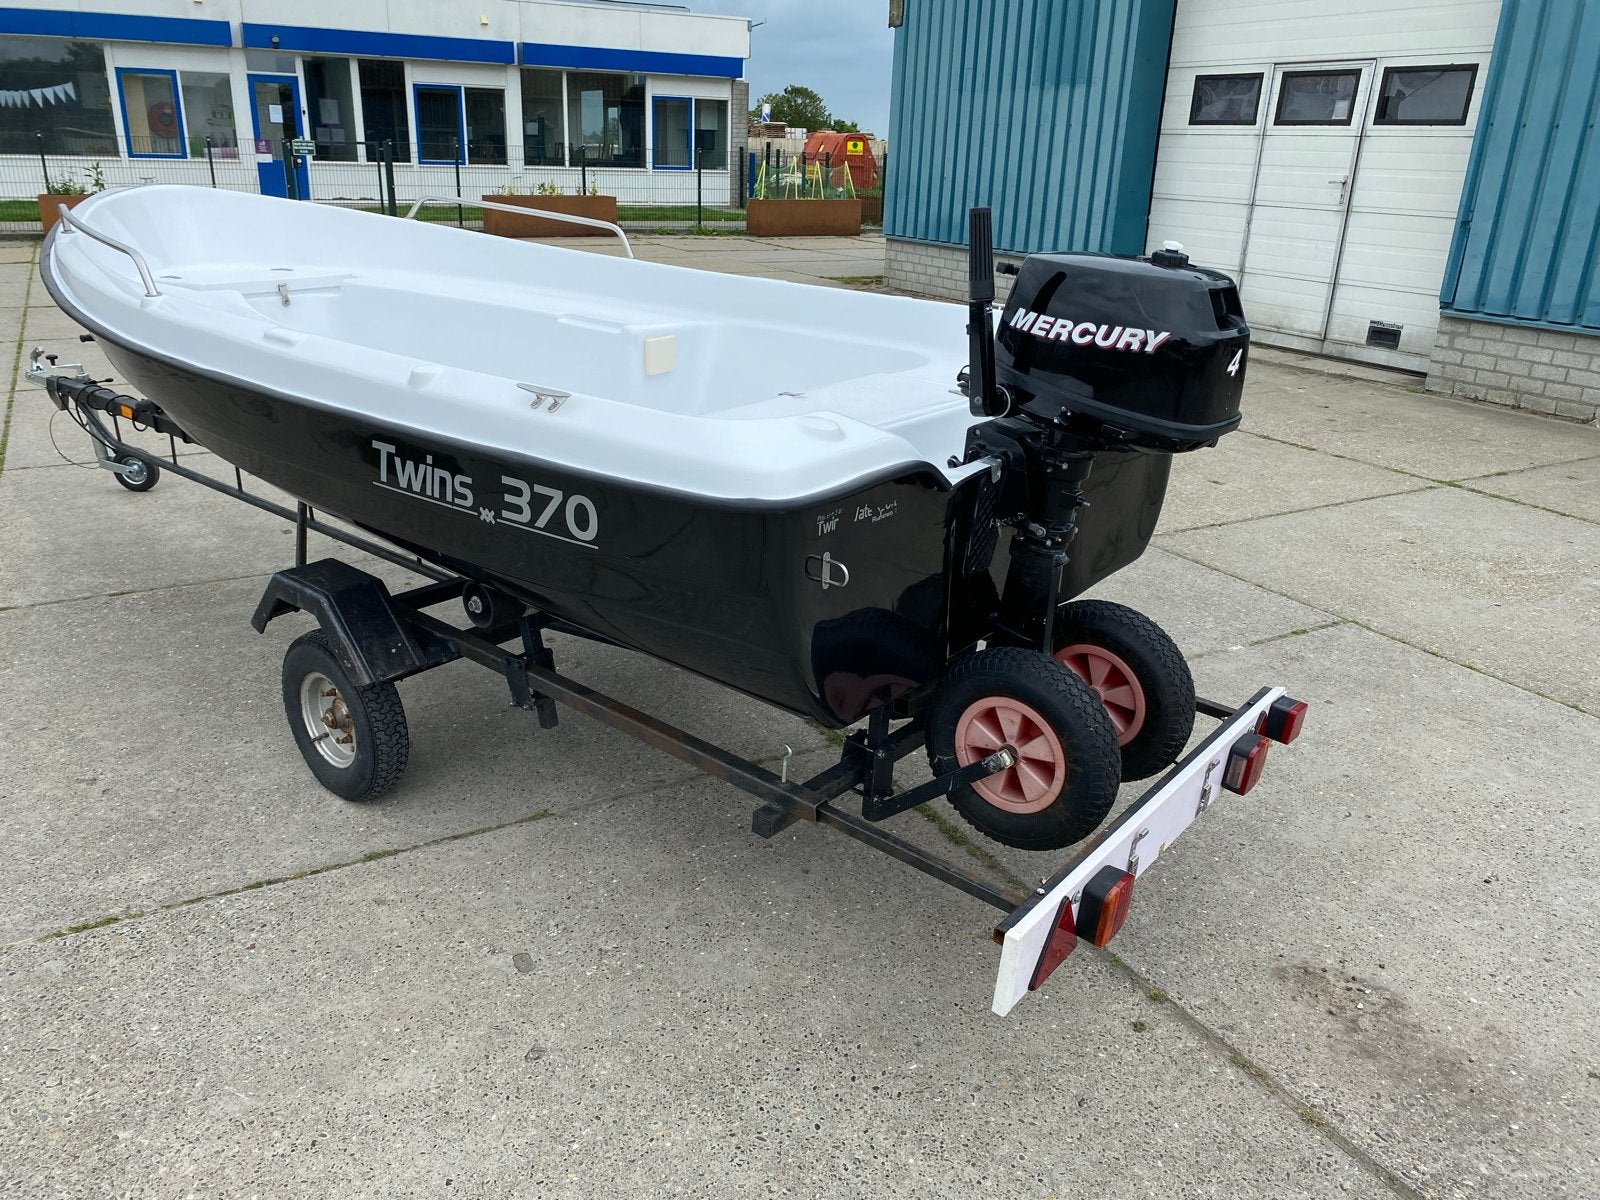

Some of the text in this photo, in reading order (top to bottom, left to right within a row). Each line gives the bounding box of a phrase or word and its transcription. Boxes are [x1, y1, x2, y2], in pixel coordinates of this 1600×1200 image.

[1009, 307, 1172, 354] MERCURY
[1226, 348, 1243, 377] 4
[372, 440, 598, 541] Twins 370
